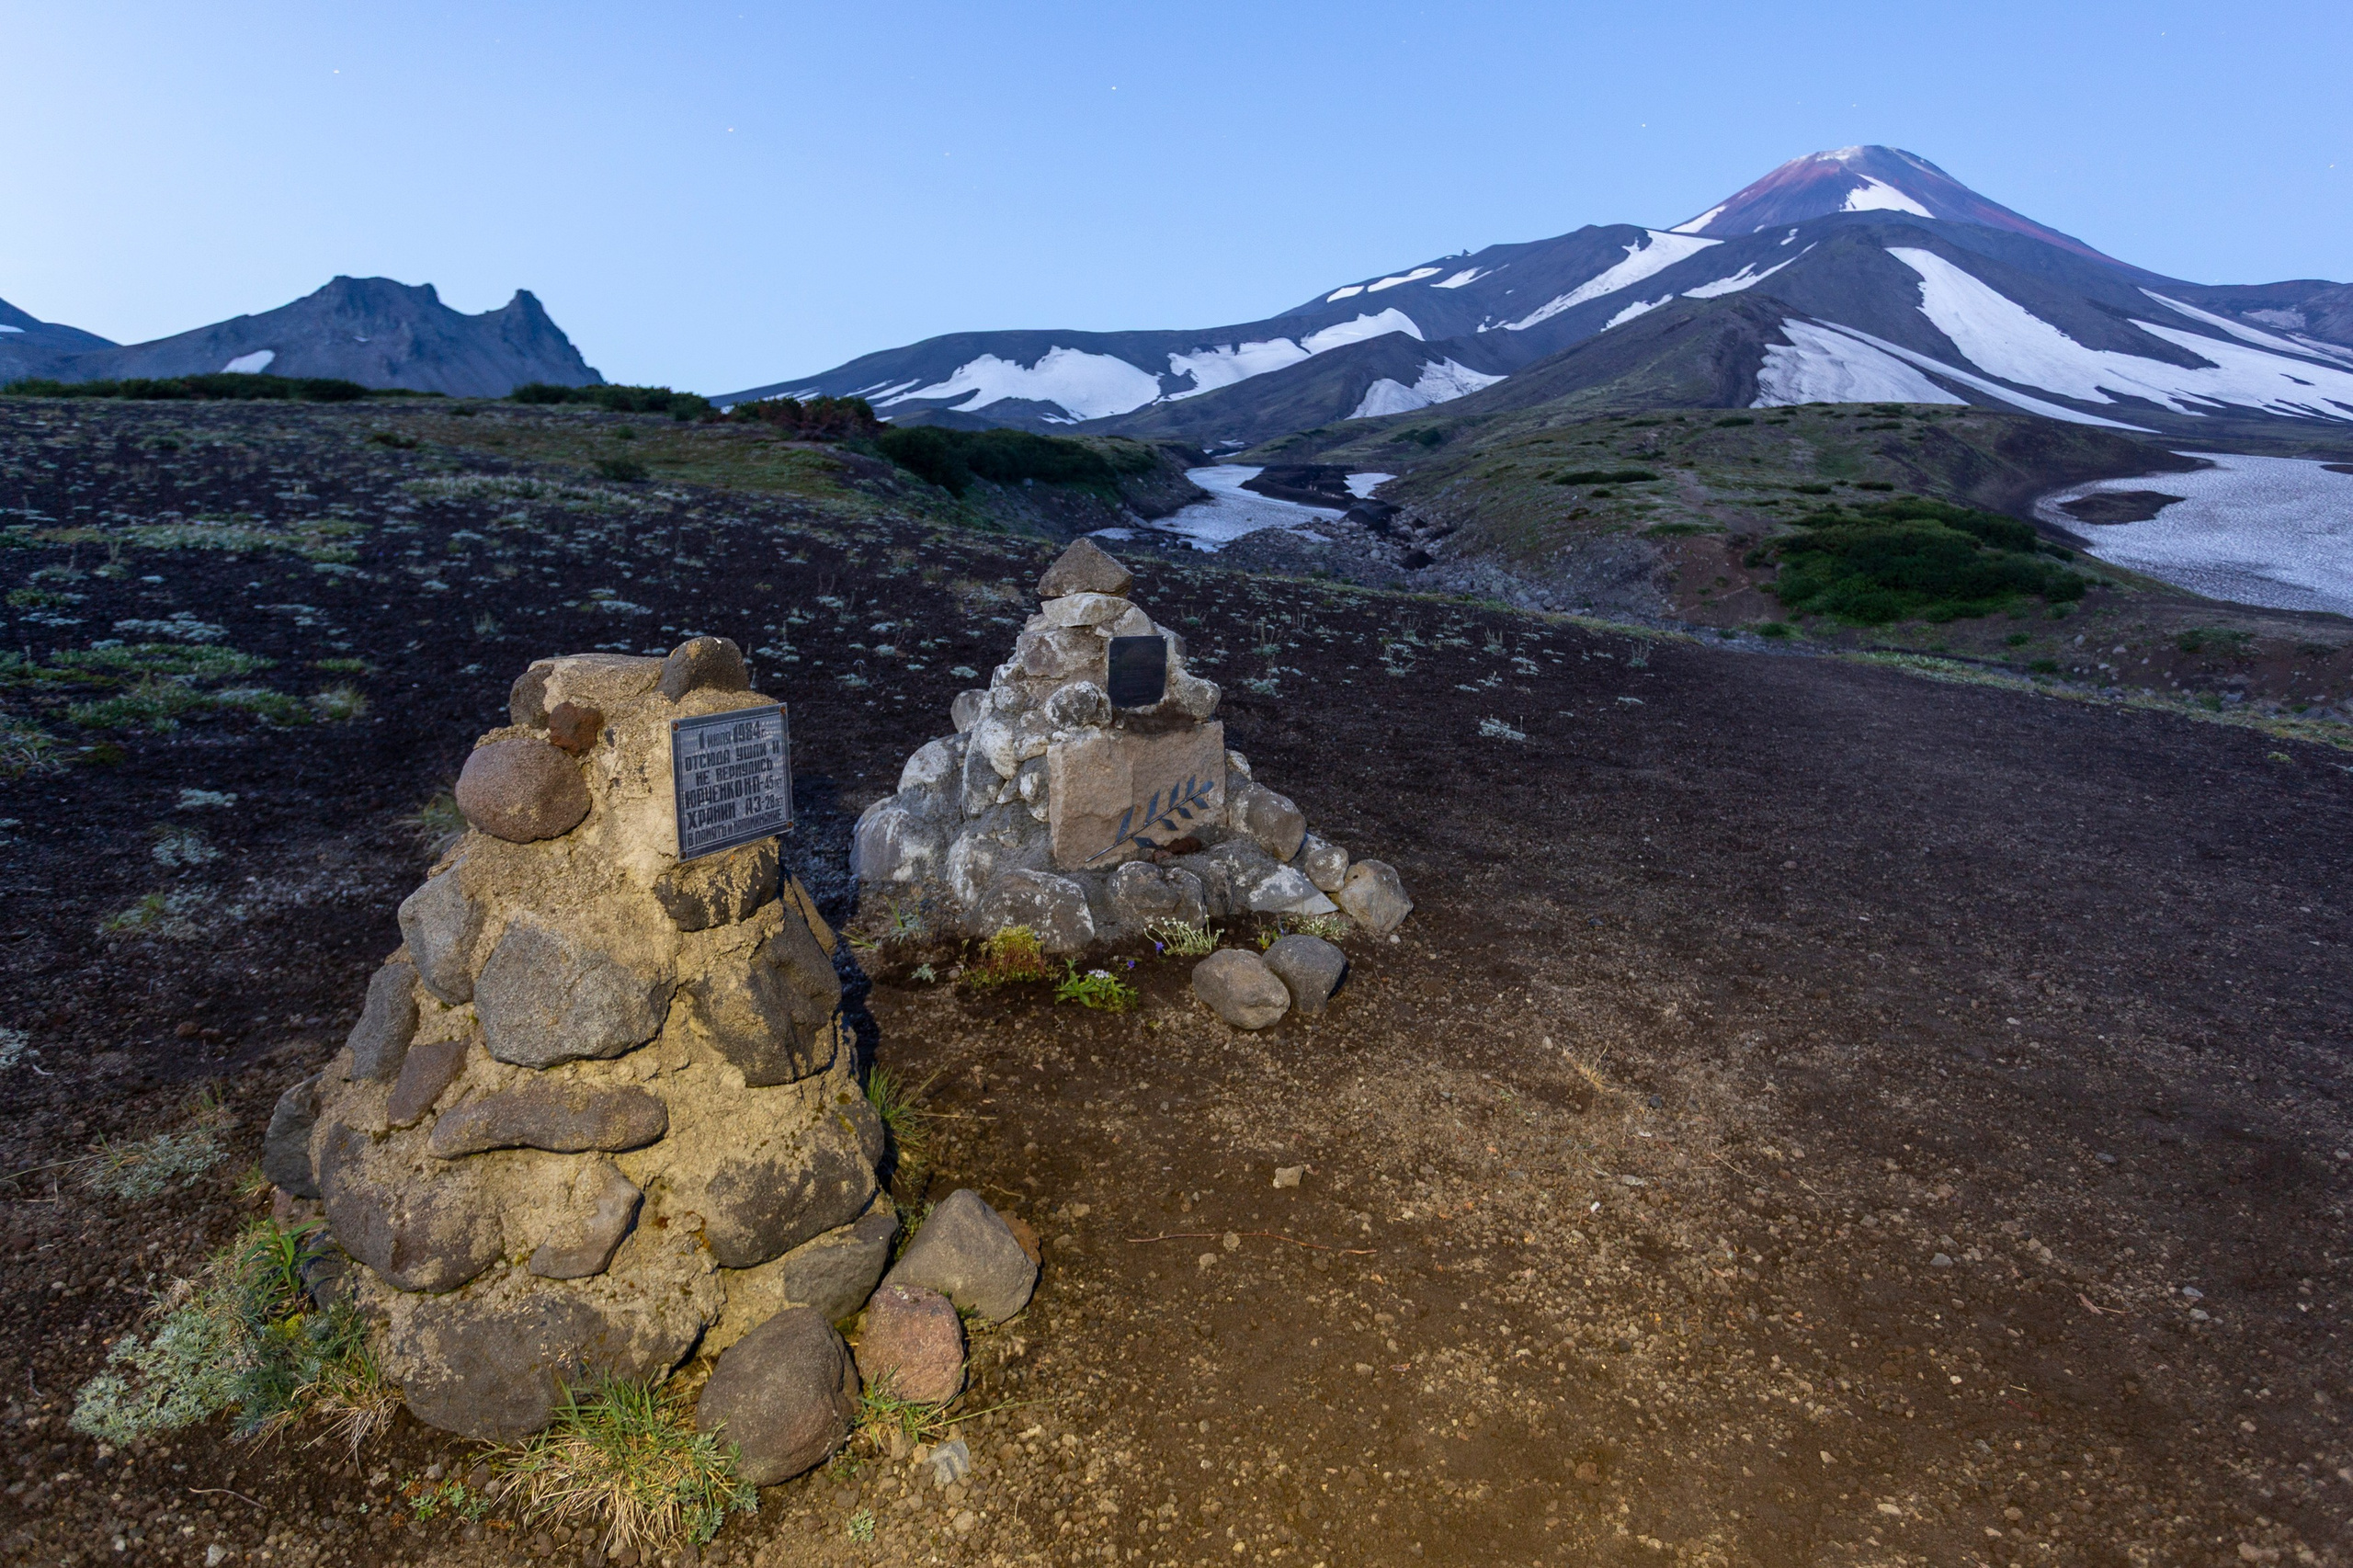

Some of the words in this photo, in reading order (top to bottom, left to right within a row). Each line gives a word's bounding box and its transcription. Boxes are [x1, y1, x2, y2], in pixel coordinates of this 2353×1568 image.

[699, 731, 705, 749] 1
[733, 721, 761, 743] 1984
[685, 749, 731, 772] ОТСЮДА
[736, 743, 767, 762] УШЛИ
[772, 740, 779, 755] И
[696, 770, 710, 787] НЕ
[716, 757, 773, 782] ВЕРНУЛИСЬ
[685, 779, 743, 810] ЮРЧЕНКО
[688, 833, 694, 847] В
[695, 824, 727, 845] ПАМЯТЬ
[728, 824, 733, 835] И
